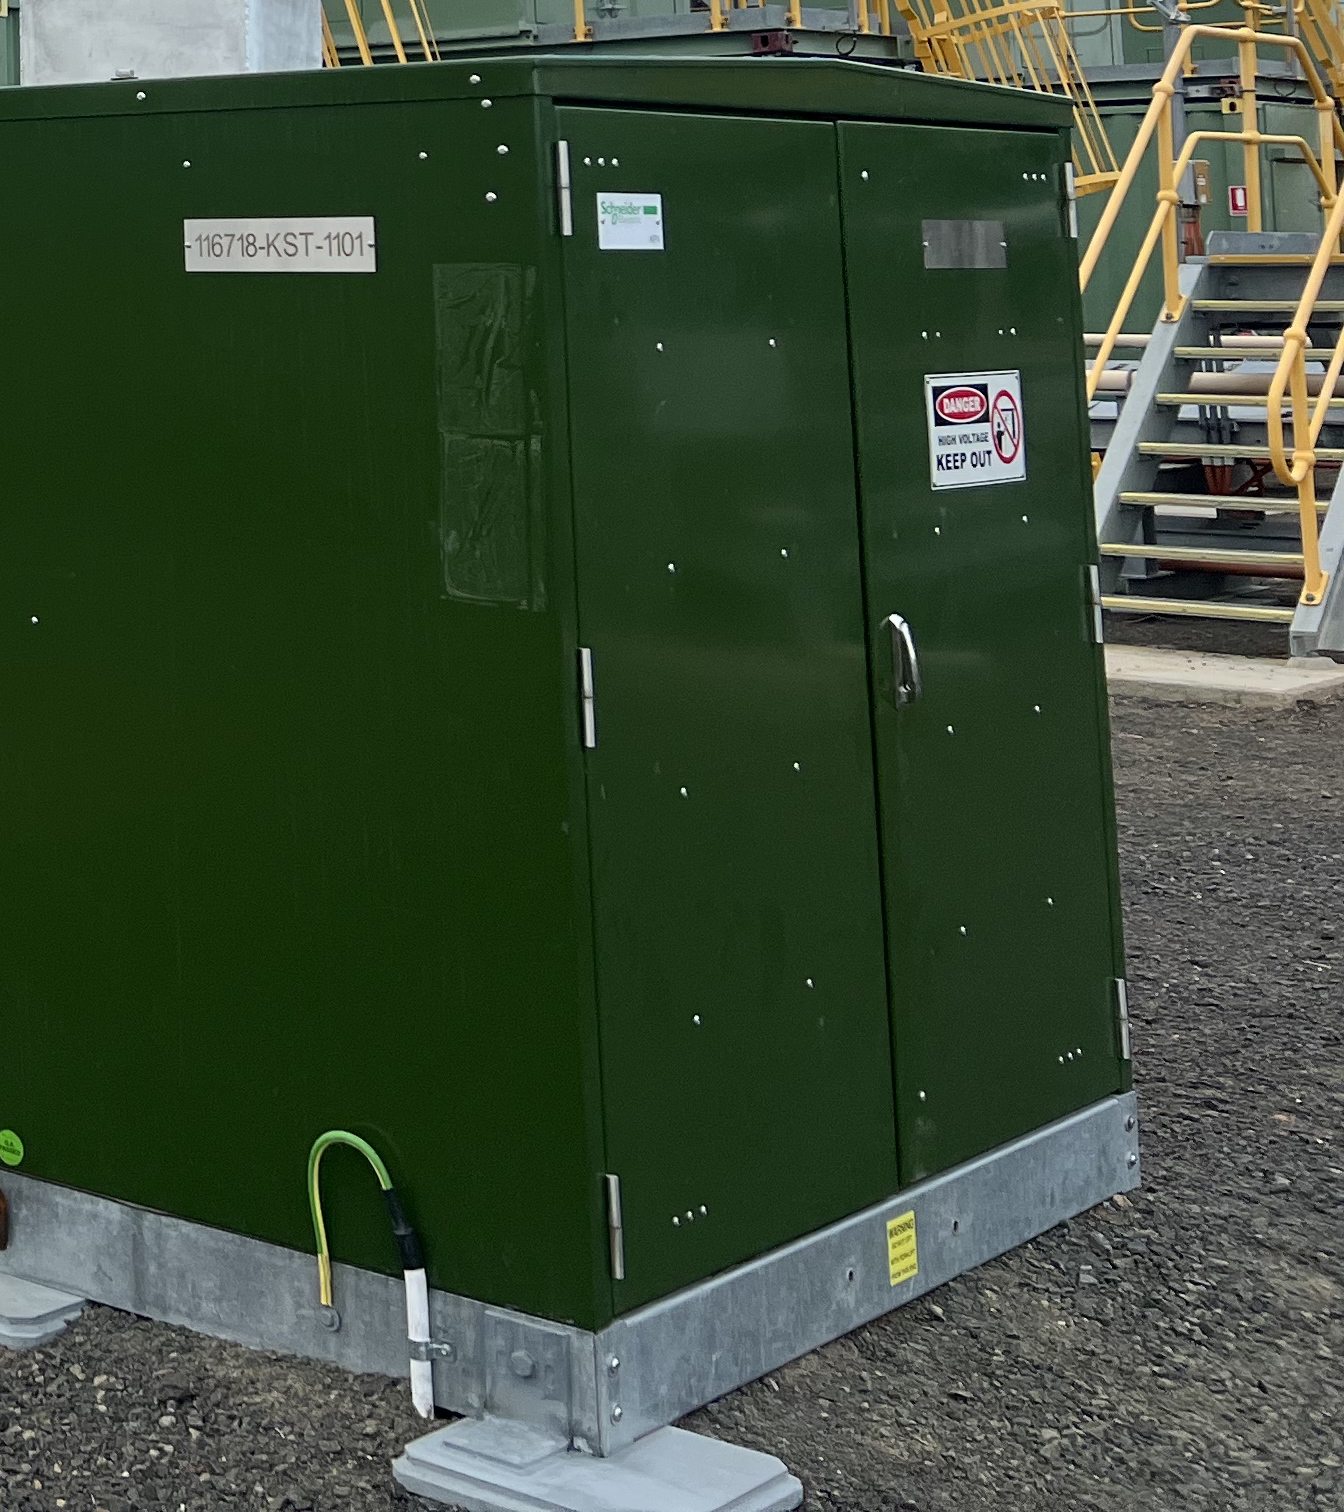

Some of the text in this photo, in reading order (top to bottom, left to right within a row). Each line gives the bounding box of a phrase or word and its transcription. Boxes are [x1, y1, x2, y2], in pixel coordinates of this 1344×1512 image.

[194, 230, 365, 259] 116718-KST-1101
[942, 395, 981, 414] DANGER
[938, 431, 990, 447] HIGH VOLTAGE
[936, 449, 993, 472] KEEP OUT
